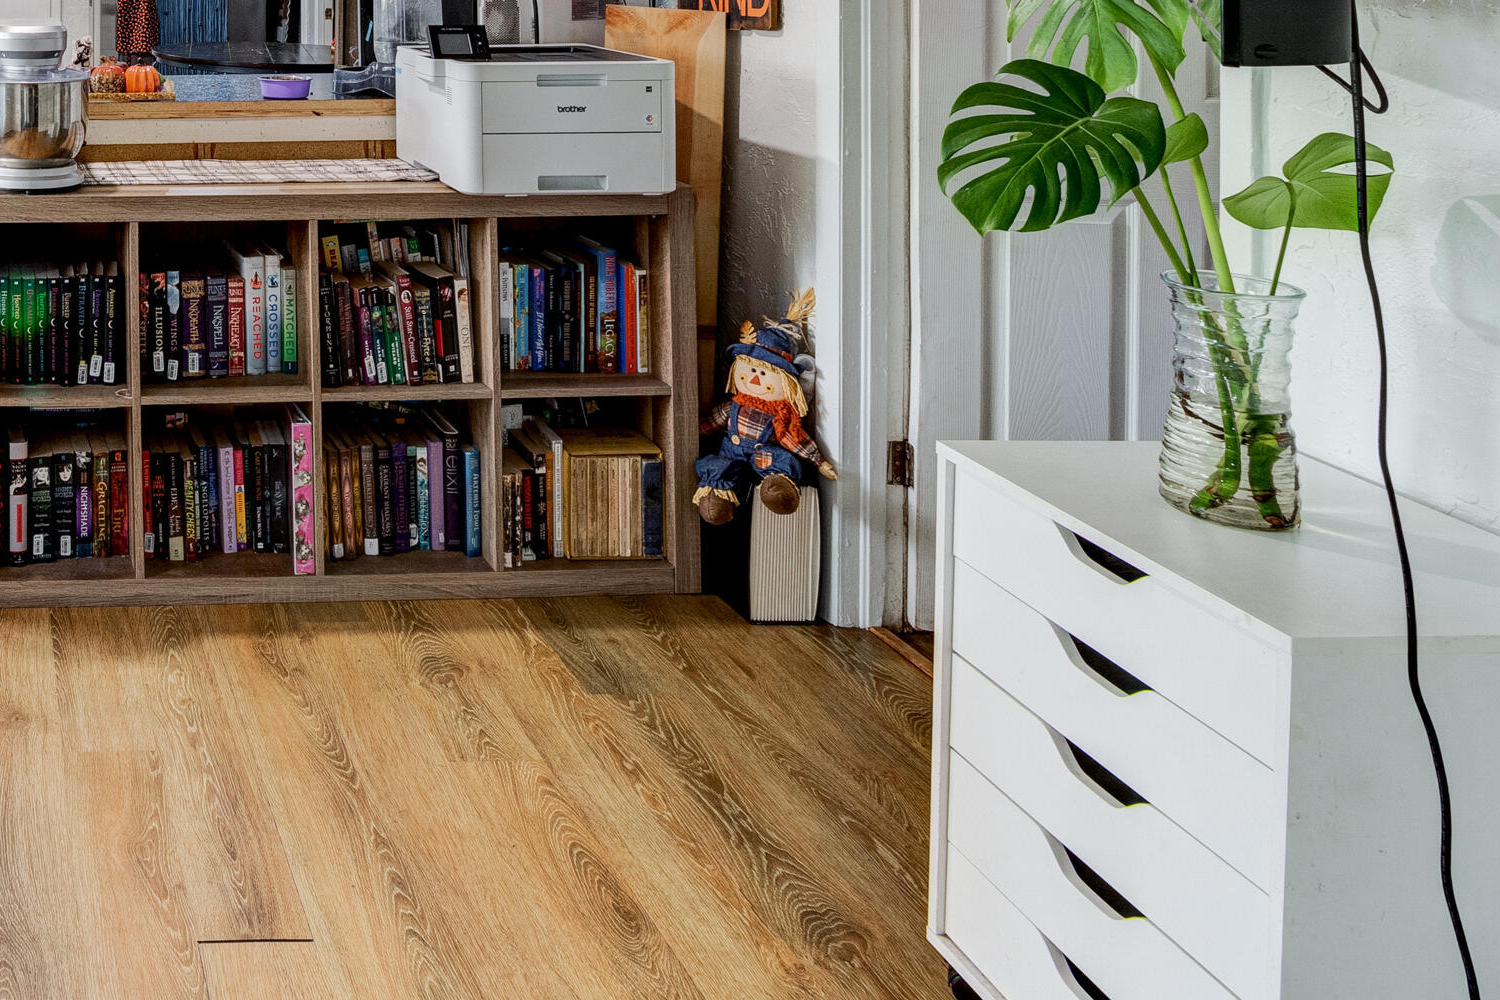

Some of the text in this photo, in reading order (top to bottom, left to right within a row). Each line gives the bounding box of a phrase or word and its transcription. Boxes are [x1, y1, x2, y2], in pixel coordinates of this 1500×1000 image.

[557, 105, 587, 113] brother
[78, 285, 86, 325] BETRAYED
[605, 256, 615, 310] NORA ROBERTS
[211, 305, 223, 349] INKSPELL
[230, 307, 241, 351] INKHEART
[252, 297, 262, 359] REACHED
[269, 294, 278, 358] CROSSED
[286, 299, 294, 355] MATCHED
[324, 304, 333, 354] TORMENT
[405, 321, 419, 363] Star-Crossed
[422, 337, 431, 357] Flyte
[604, 319, 616, 358] LEGACY
[80, 486, 88, 537] NIGHTSHADE
[97, 482, 107, 542] GRACELING
[170, 488, 178, 510] EDEN
[185, 480, 194, 511] REALITY
[186, 512, 195, 539] CHECK
